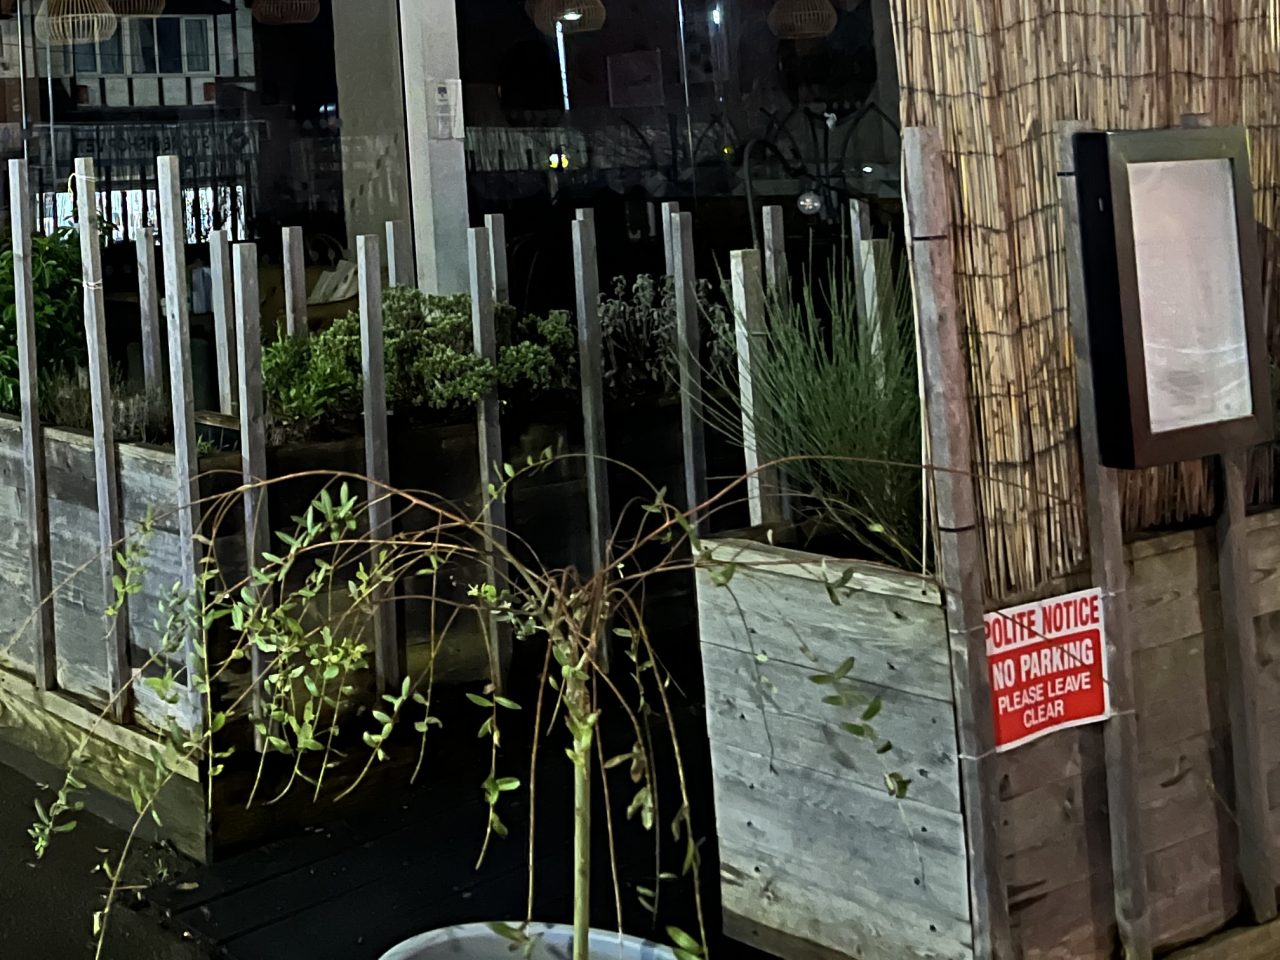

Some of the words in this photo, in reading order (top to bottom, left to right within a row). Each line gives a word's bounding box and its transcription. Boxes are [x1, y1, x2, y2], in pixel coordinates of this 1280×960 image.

[1042, 594, 1100, 635] NOTICE
[992, 658, 1016, 691] NO
[1020, 638, 1094, 682] PARKING
[998, 683, 1045, 716] PLEASE
[1047, 672, 1092, 698] LEAVE
[1023, 699, 1064, 729] CLEAR
